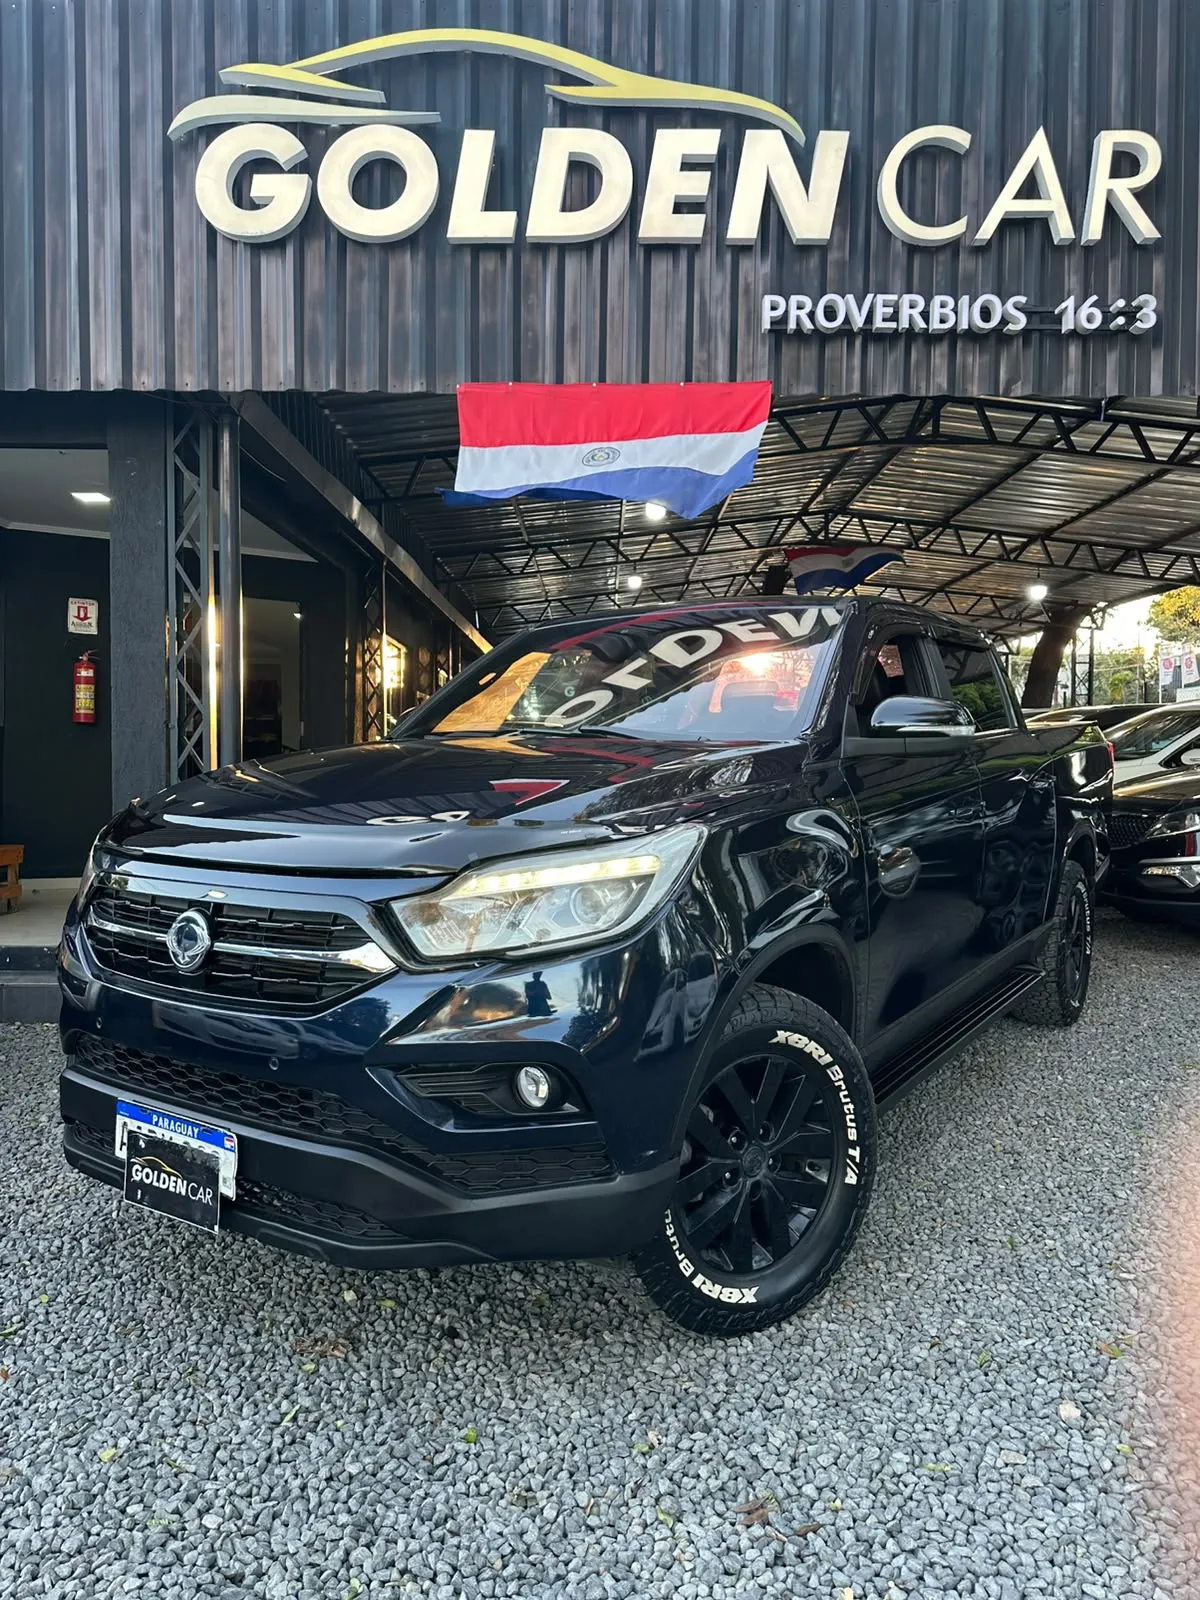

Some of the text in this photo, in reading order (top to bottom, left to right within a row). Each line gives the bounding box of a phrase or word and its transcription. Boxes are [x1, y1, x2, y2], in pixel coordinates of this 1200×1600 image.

[195, 123, 1162, 246] GOLDEN CAR
[761, 292, 1158, 335] PROVERBIOS 16:3
[152, 1114, 200, 1139] PARAGUAY
[768, 1030, 860, 1185] XBRI Brutus T/A
[131, 1164, 213, 1206] GOLDEN CAR
[664, 1209, 760, 1305] XBRI Brutu
